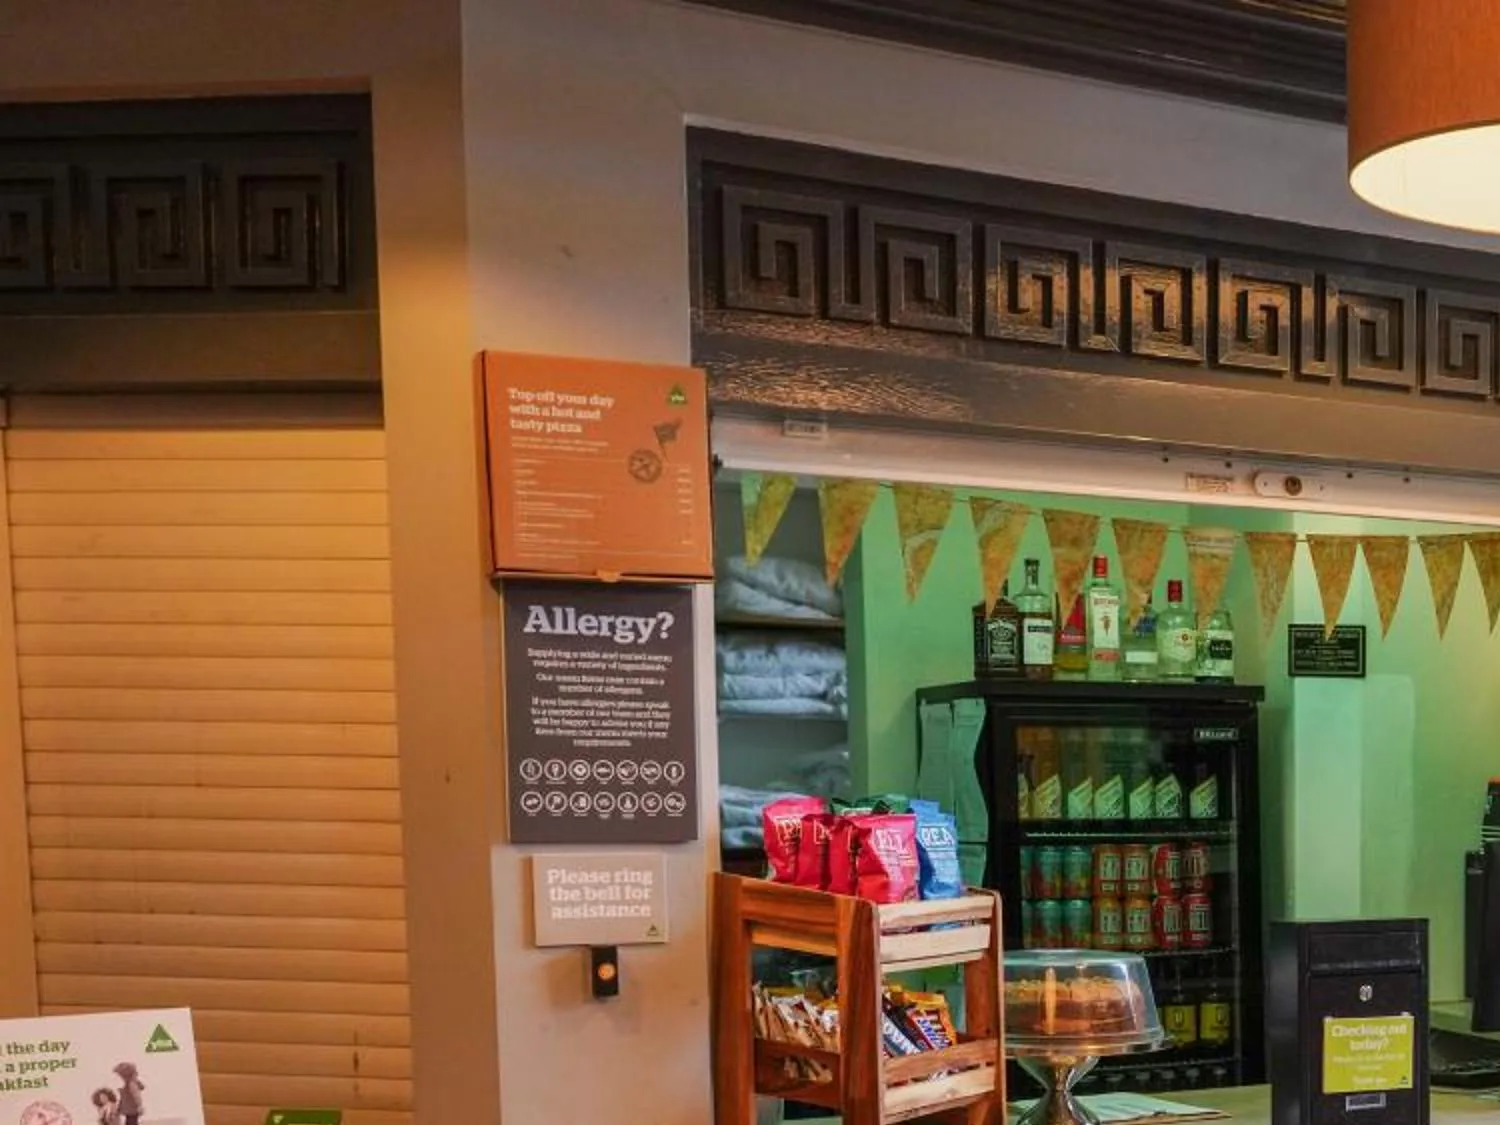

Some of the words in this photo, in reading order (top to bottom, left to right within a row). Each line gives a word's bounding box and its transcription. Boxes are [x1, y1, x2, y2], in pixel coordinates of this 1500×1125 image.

[523, 605, 674, 644] Allergy?
[547, 868, 610, 884] Please
[615, 867, 653, 885] ring
[549, 886, 581, 901] the
[584, 885, 622, 901] bell
[625, 884, 652, 900] for
[551, 903, 652, 919] assistance
[7, 1041, 34, 1055] the
[39, 1040, 70, 1054] day
[5, 1063, 15, 1072] a
[19, 1059, 77, 1075] proper
